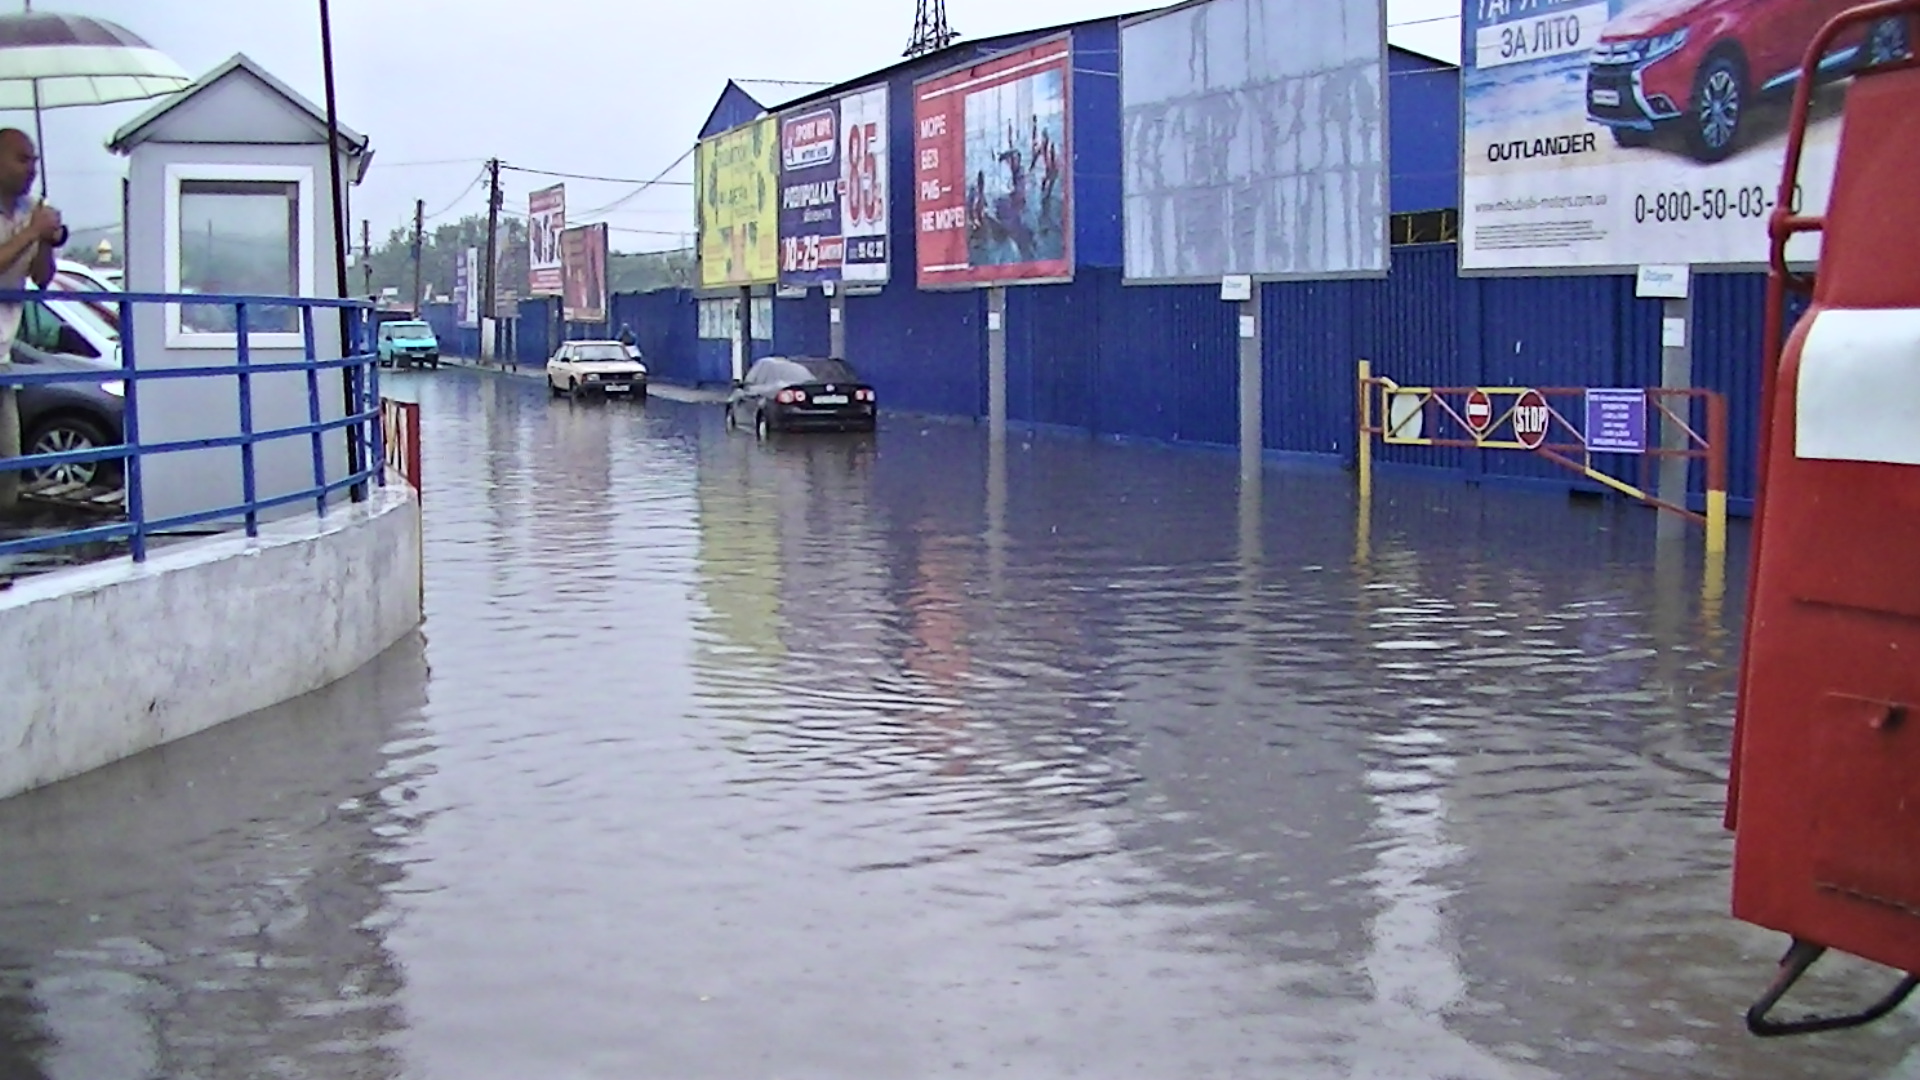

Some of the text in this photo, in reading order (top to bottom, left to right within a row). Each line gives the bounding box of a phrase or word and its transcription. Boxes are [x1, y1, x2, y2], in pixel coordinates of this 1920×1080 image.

[1501, 14, 1580, 58] ЗА ЛІТО
[920, 114, 947, 139] МОРЕ
[1488, 132, 1596, 162] OUTLANDER
[1635, 183, 1803, 224] 0-800-50-03-0
